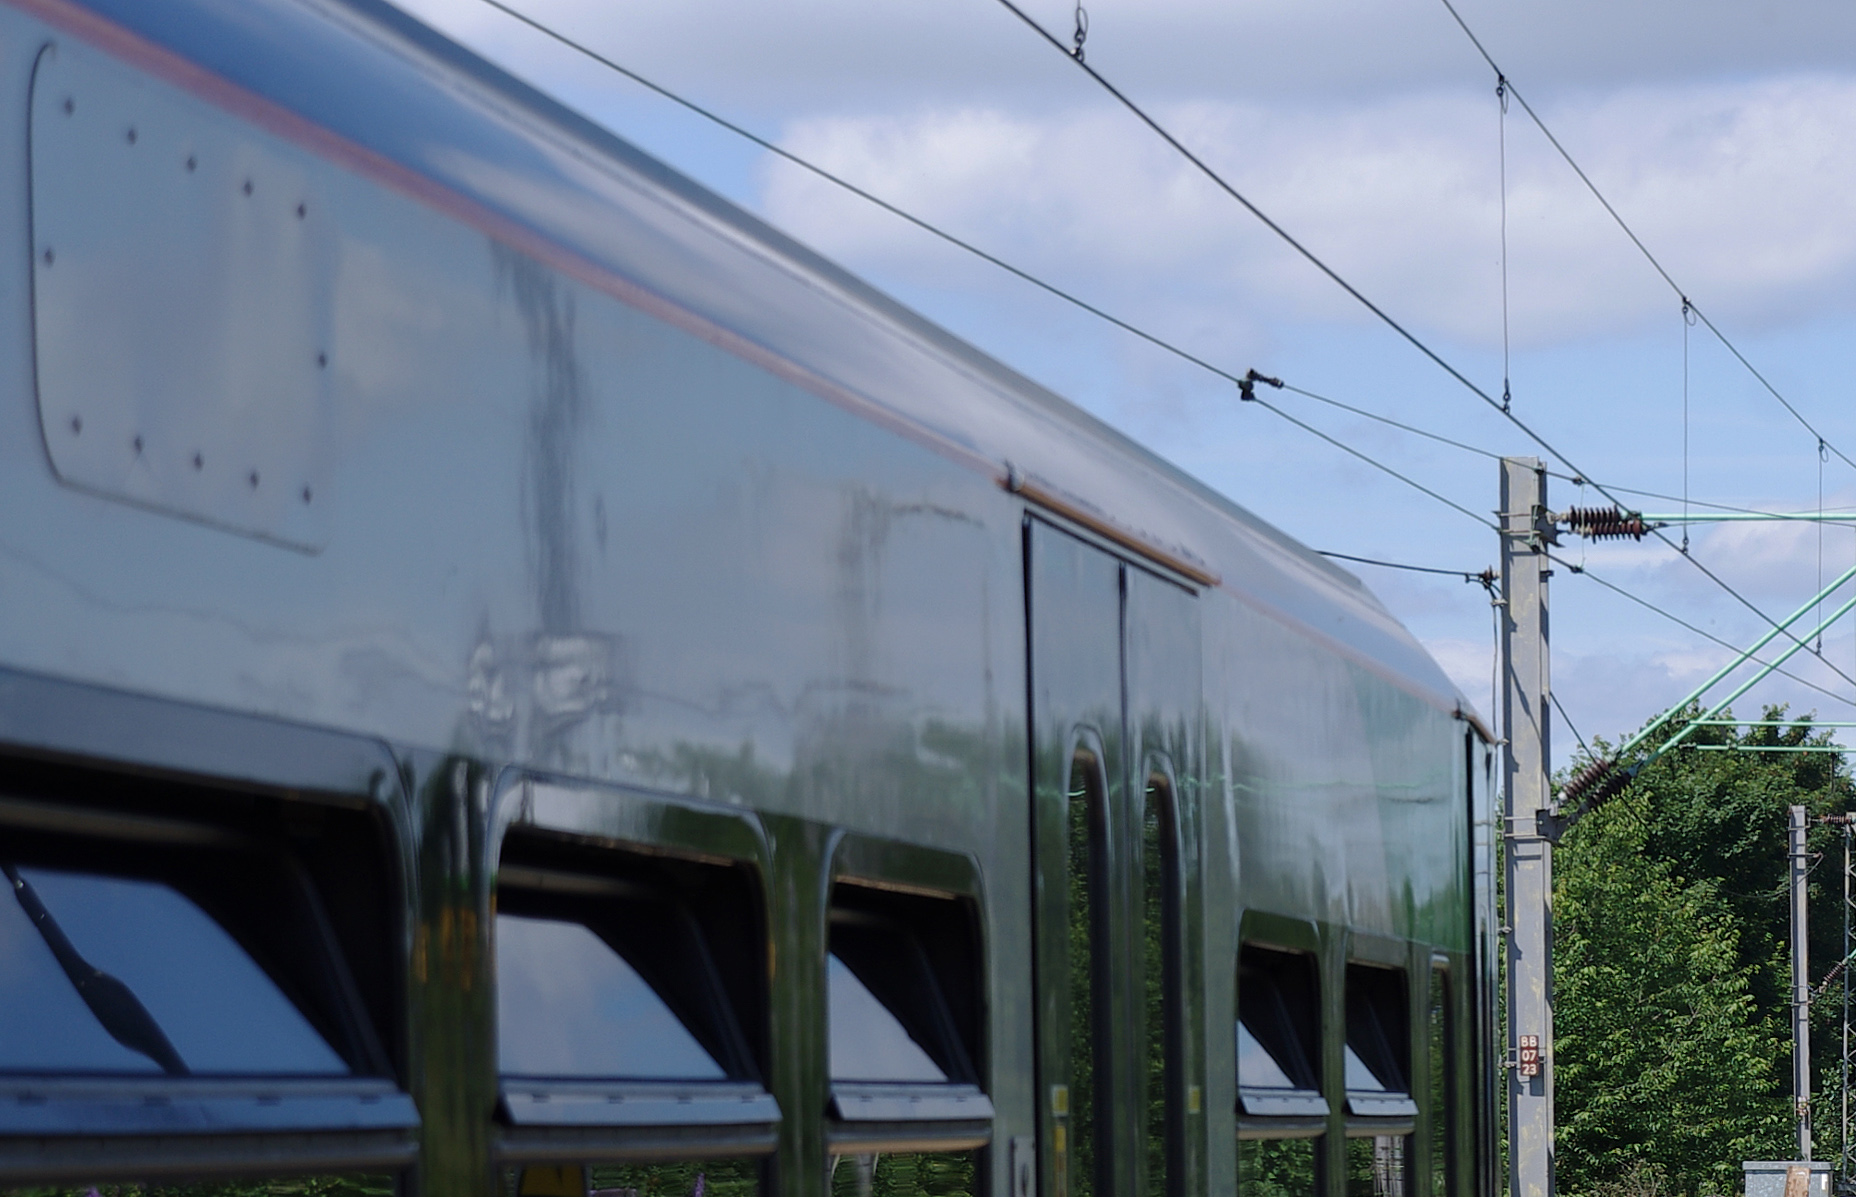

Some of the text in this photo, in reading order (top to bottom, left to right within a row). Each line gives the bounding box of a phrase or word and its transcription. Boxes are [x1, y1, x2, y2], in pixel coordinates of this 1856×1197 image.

[1520, 1036, 1537, 1047] BB
[1521, 1050, 1537, 1061] 07
[1522, 1064, 1537, 1075] 23
